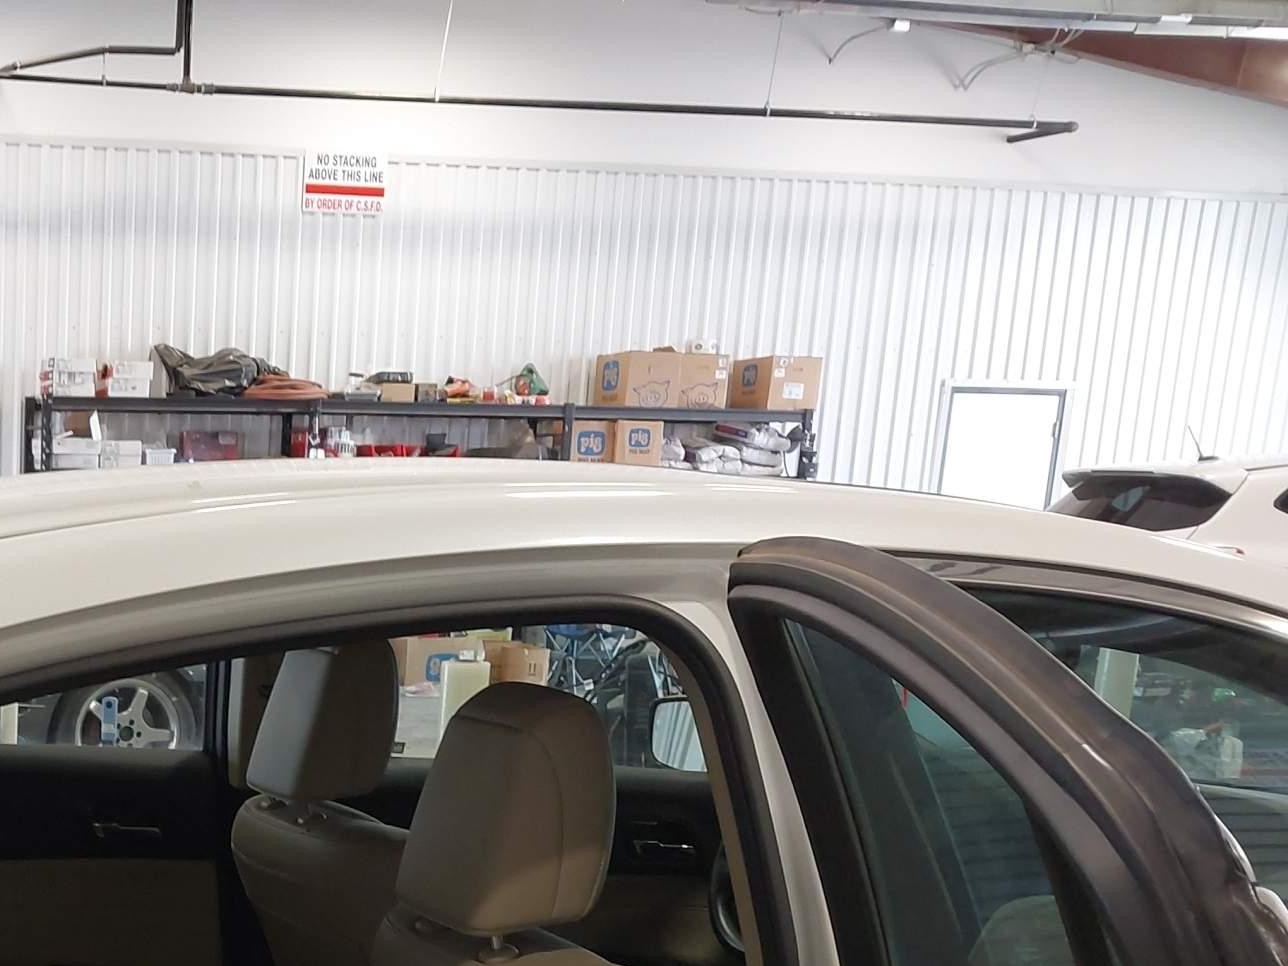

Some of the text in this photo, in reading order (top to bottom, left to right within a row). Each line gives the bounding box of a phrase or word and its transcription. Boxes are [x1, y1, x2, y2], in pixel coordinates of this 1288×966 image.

[317, 153, 377, 168] NO STACKING
[308, 168, 384, 183] ABOVE THIS LINE
[305, 198, 314, 209] BY
[316, 199, 342, 211] ORDER
[344, 200, 354, 211] OF
